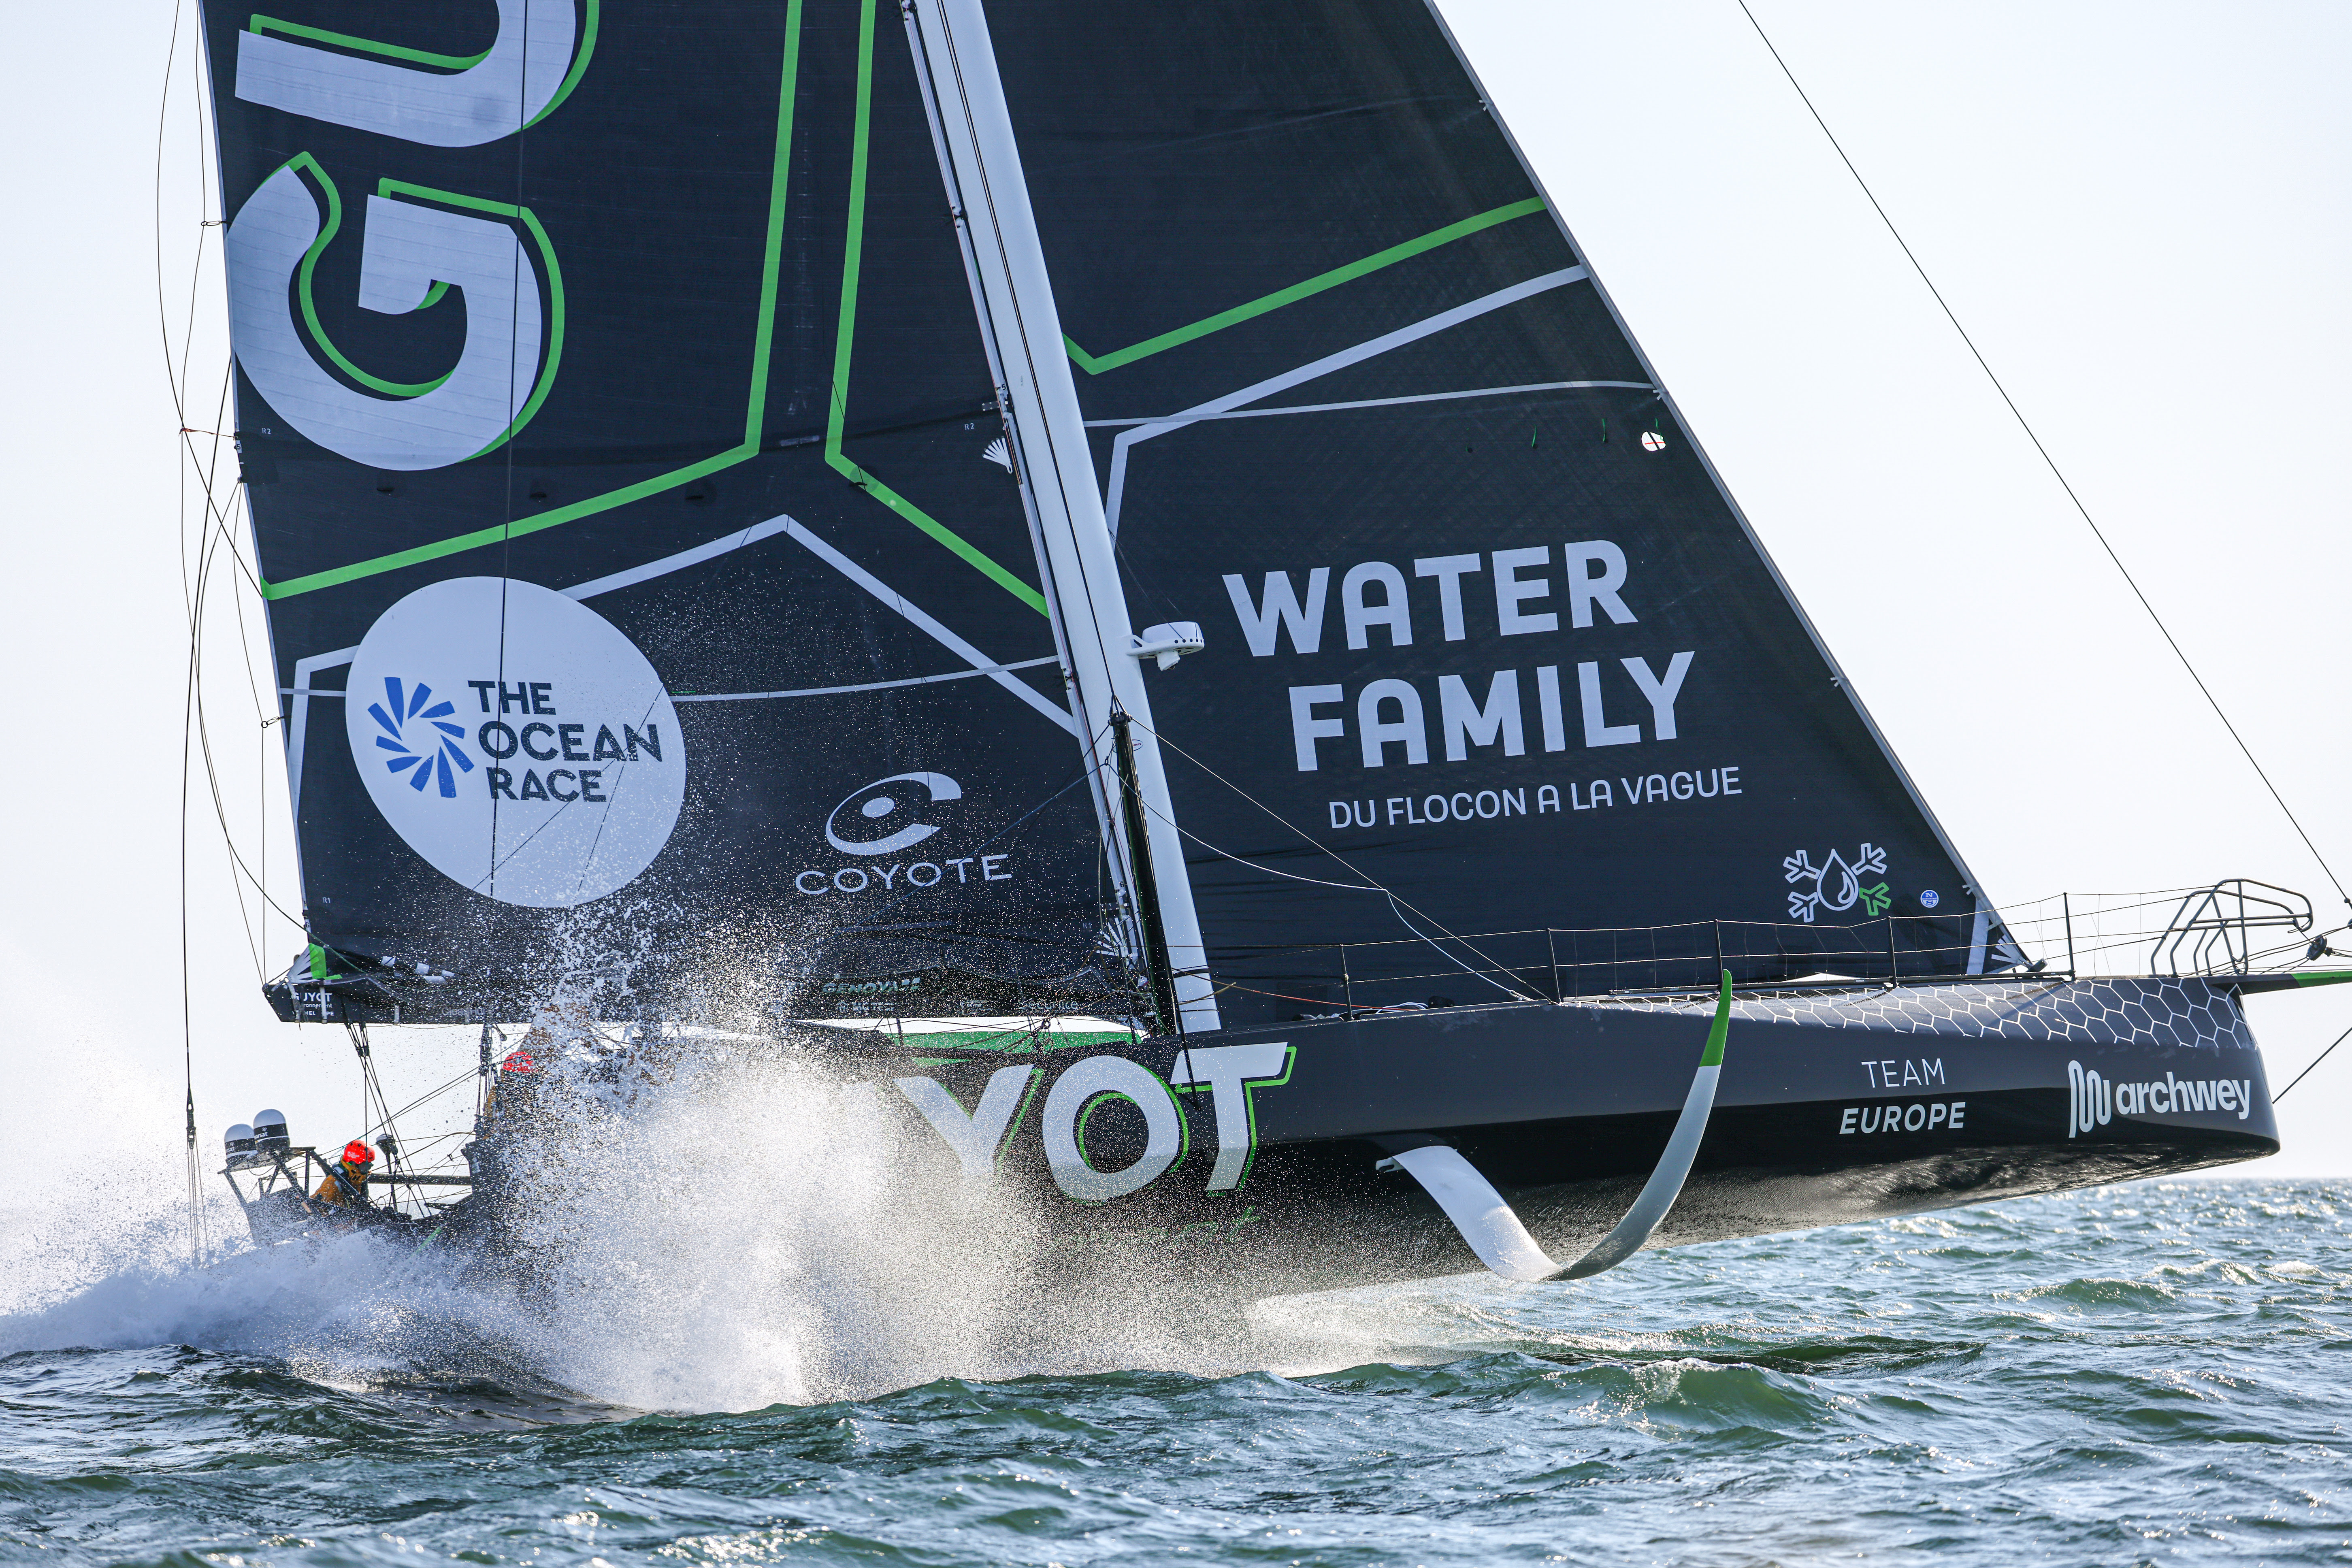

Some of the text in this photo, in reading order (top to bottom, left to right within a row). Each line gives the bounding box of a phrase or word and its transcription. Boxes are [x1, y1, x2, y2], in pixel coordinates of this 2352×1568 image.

[1222, 540, 1638, 656] WATER
[468, 680, 556, 715] THE
[1289, 651, 1695, 771] FAMILY
[478, 721, 663, 763] OCEAN
[486, 769, 607, 802] RACE
[1329, 767, 1742, 829] DU FLOCON A LA VAGUE
[795, 854, 1012, 895] COYOTE
[1862, 1058, 1945, 1088] TEAM
[2116, 1071, 2250, 1120] archwey
[1840, 1102, 1966, 1134] EUROPE
